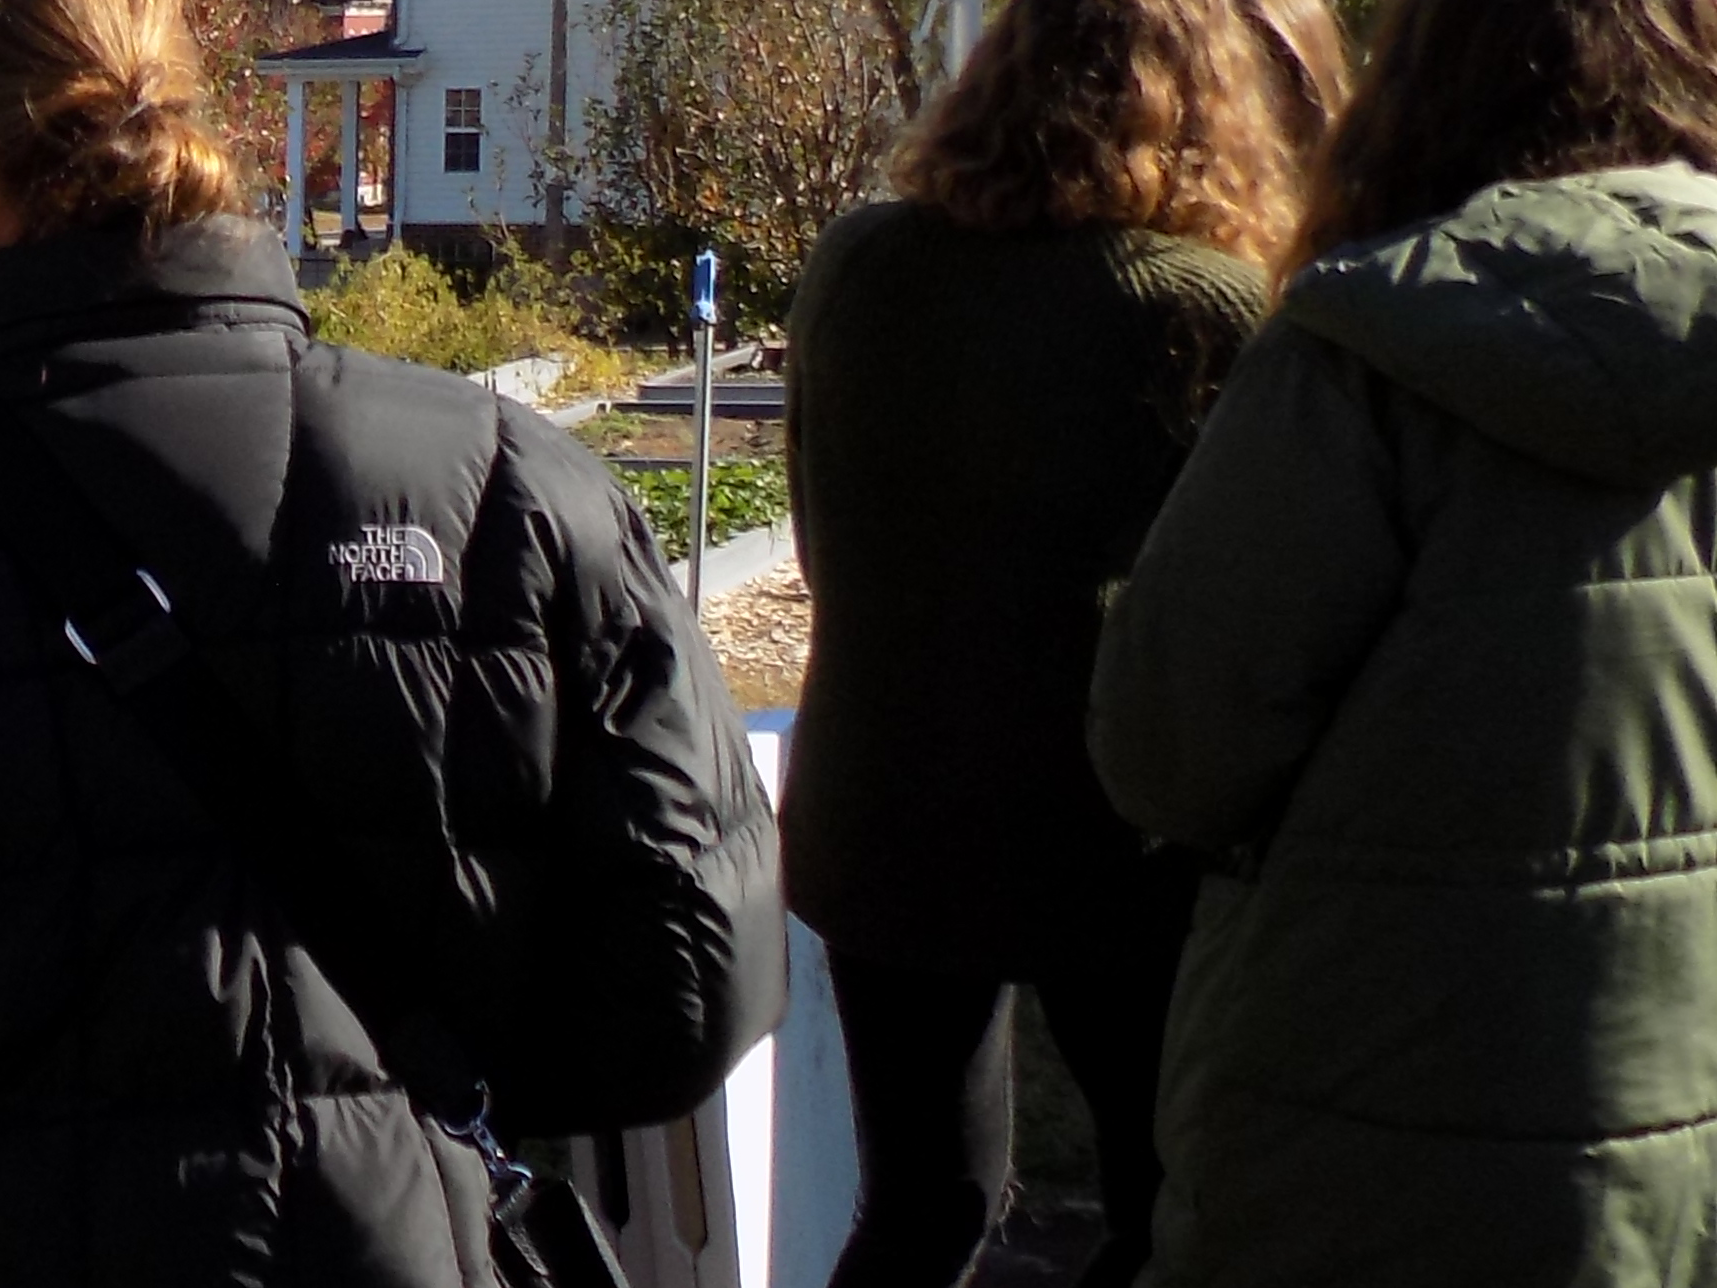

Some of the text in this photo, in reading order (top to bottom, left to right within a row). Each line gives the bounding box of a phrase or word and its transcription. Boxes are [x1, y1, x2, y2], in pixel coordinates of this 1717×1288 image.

[360, 526, 406, 544] THE
[327, 543, 405, 565] NORTH
[351, 564, 405, 582] FACE
